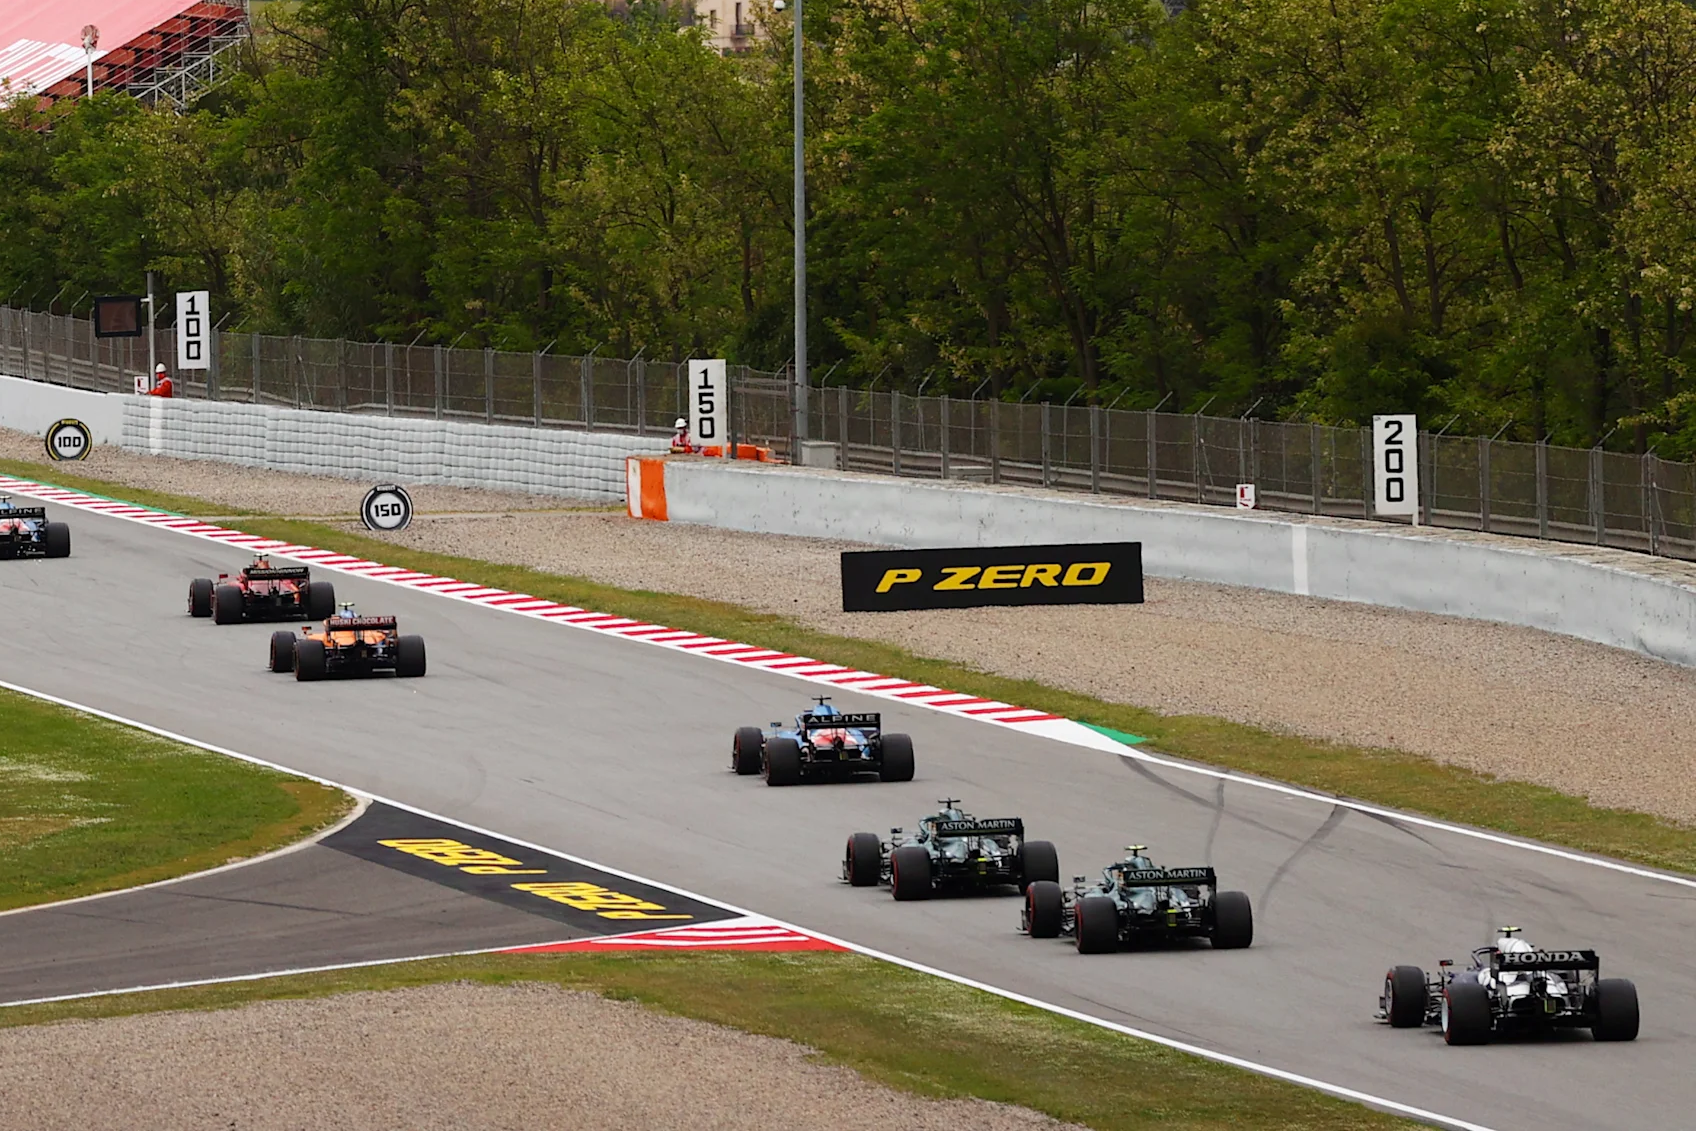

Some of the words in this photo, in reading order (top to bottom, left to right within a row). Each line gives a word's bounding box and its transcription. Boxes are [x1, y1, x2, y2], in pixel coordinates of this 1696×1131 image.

[185, 295, 201, 360] 100
[698, 367, 715, 439] 150
[58, 436, 82, 448] 100
[1384, 420, 1404, 502] 200
[375, 504, 401, 517] 150
[875, 568, 923, 593] P
[933, 562, 1111, 591] ZERO
[353, 616, 395, 625] CHOCOLATE
[807, 713, 877, 723] ALPINE
[940, 820, 976, 831] ASTON
[977, 818, 1016, 829] MARTIN
[1128, 869, 1165, 881] ASTON
[1167, 868, 1207, 880] MARTIN
[1504, 951, 1586, 962] HONDA
